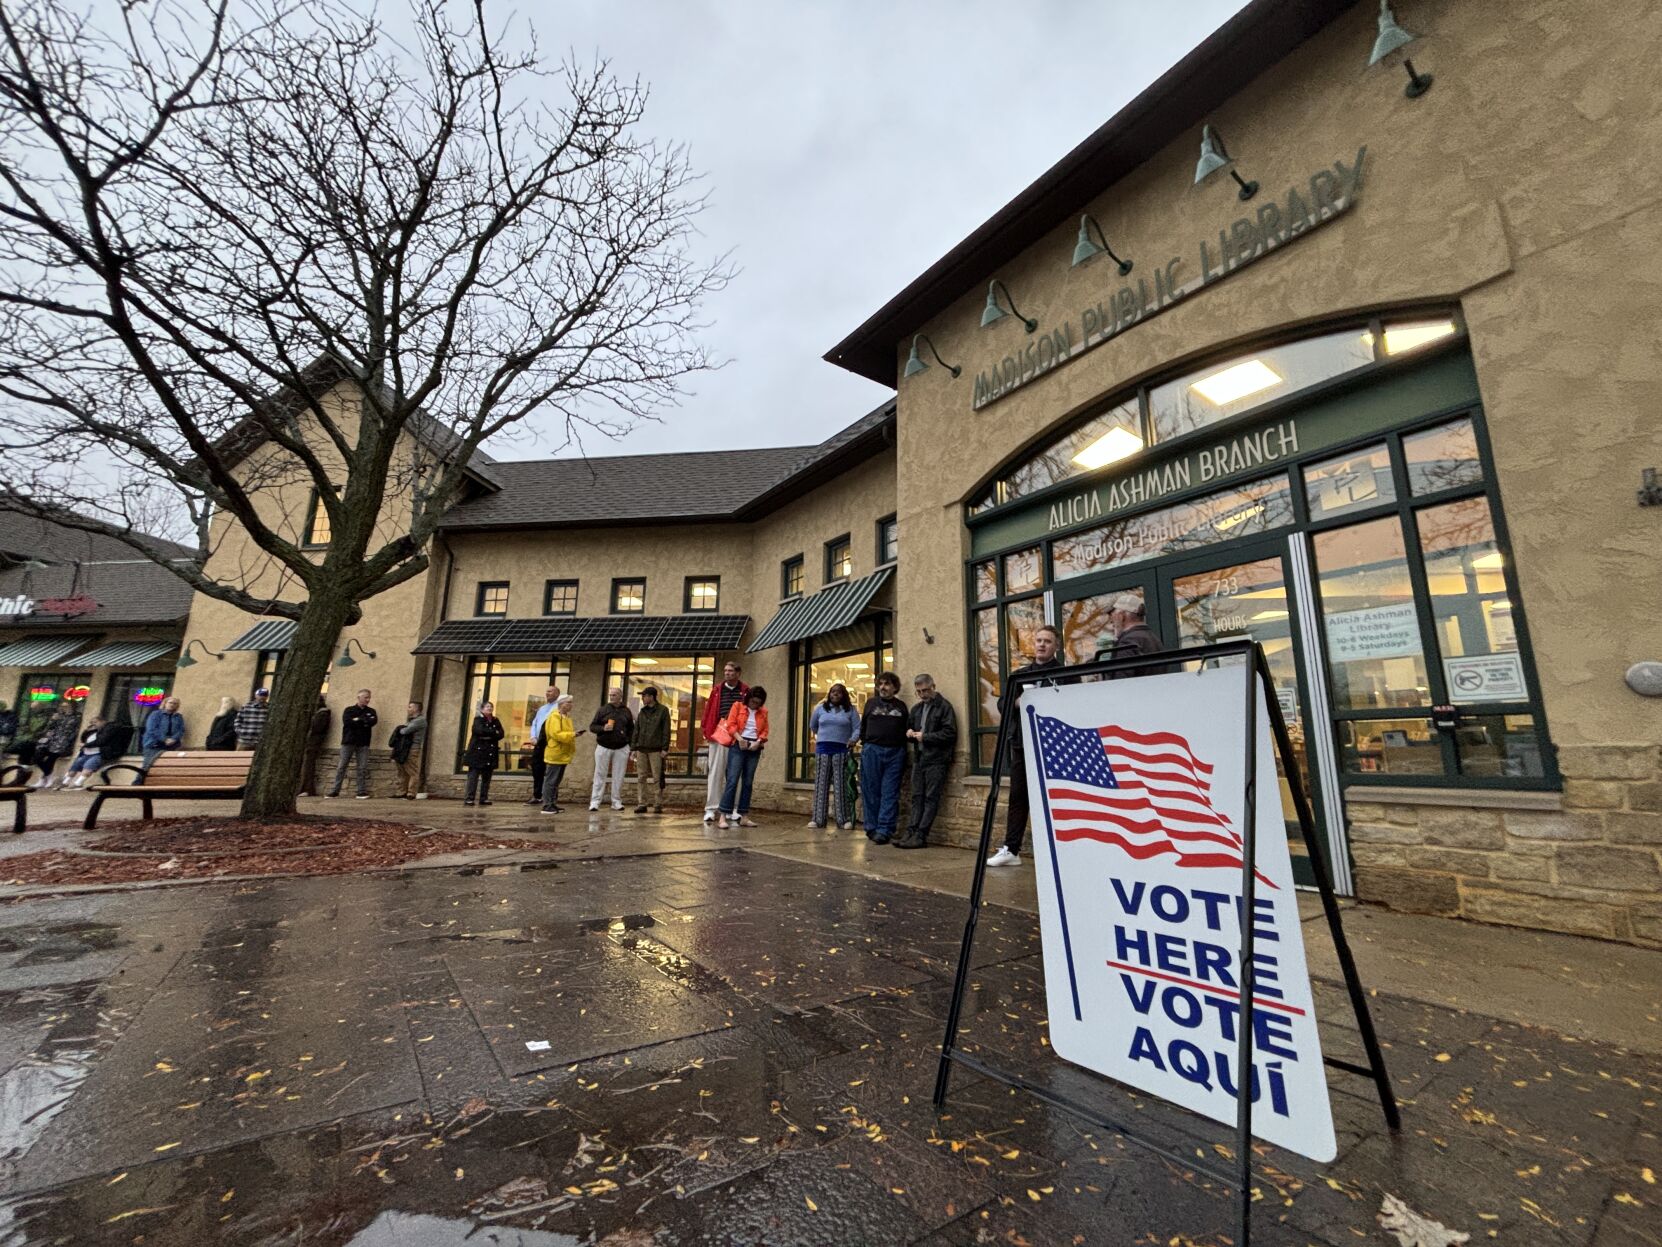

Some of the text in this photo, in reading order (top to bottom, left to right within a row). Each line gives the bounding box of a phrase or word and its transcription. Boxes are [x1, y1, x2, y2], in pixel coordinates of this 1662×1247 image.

[973, 145, 1368, 411] MADISON PUBLIC LIBRARY
[1049, 420, 1299, 530] ALICIA ASHMAN BRANCH
[1073, 535, 1133, 564] Madison
[0, 595, 34, 614] hic
[1213, 576, 1239, 598] 733
[1213, 614, 1248, 633] HOURS
[1109, 877, 1280, 942] VOTE
[1114, 924, 1284, 1000] HERE
[1119, 972, 1299, 1062] VOTE
[1128, 1026, 1290, 1119] AQUÍ
